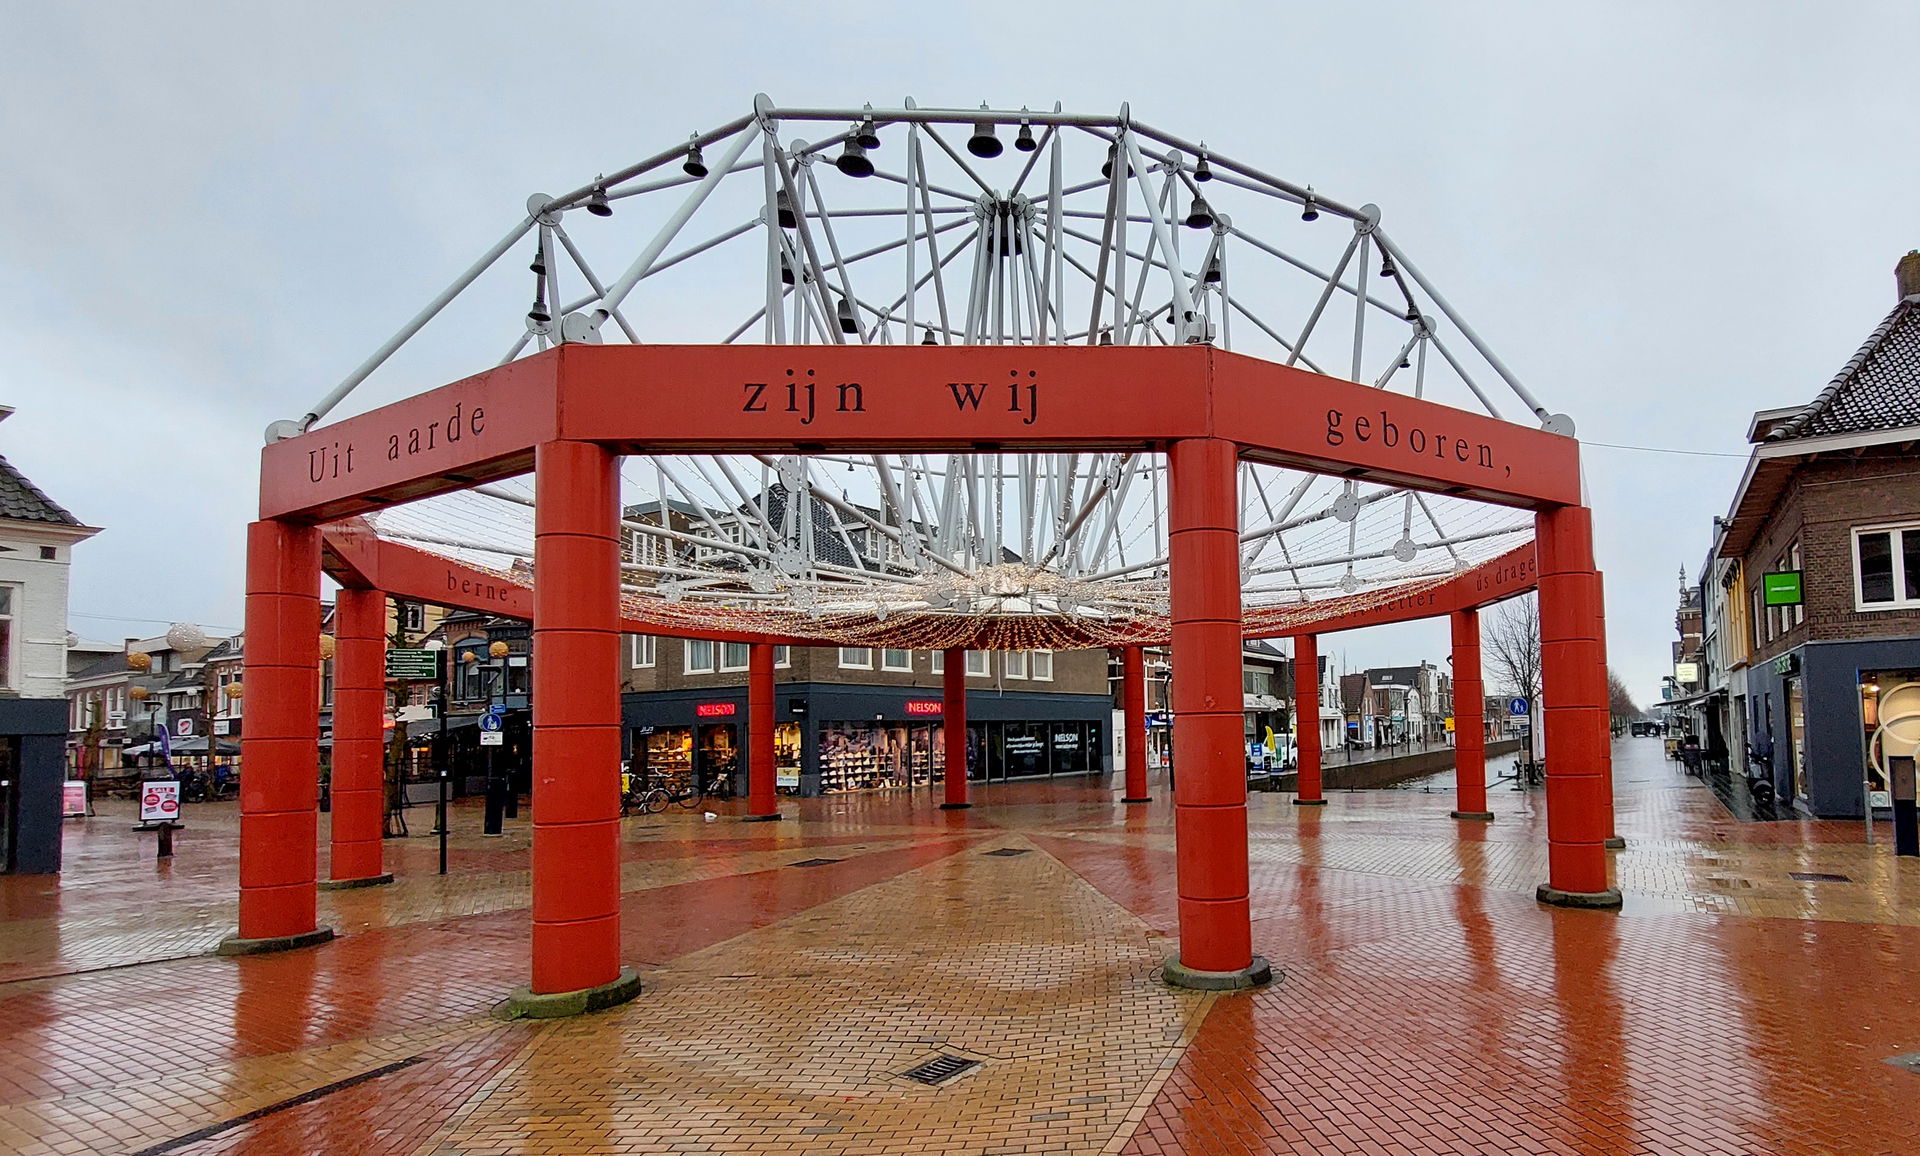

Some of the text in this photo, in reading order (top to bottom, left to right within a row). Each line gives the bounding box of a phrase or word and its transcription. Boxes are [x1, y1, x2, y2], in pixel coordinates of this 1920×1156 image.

[742, 368, 1038, 425] zijn wij
[308, 402, 485, 483] Uit aarde
[1326, 409, 1511, 478] geboren,
[1495, 558, 1535, 582] drage
[698, 703, 735, 716] NELSON
[908, 702, 942, 713] NELSON
[1054, 733, 1079, 742] NELSON
